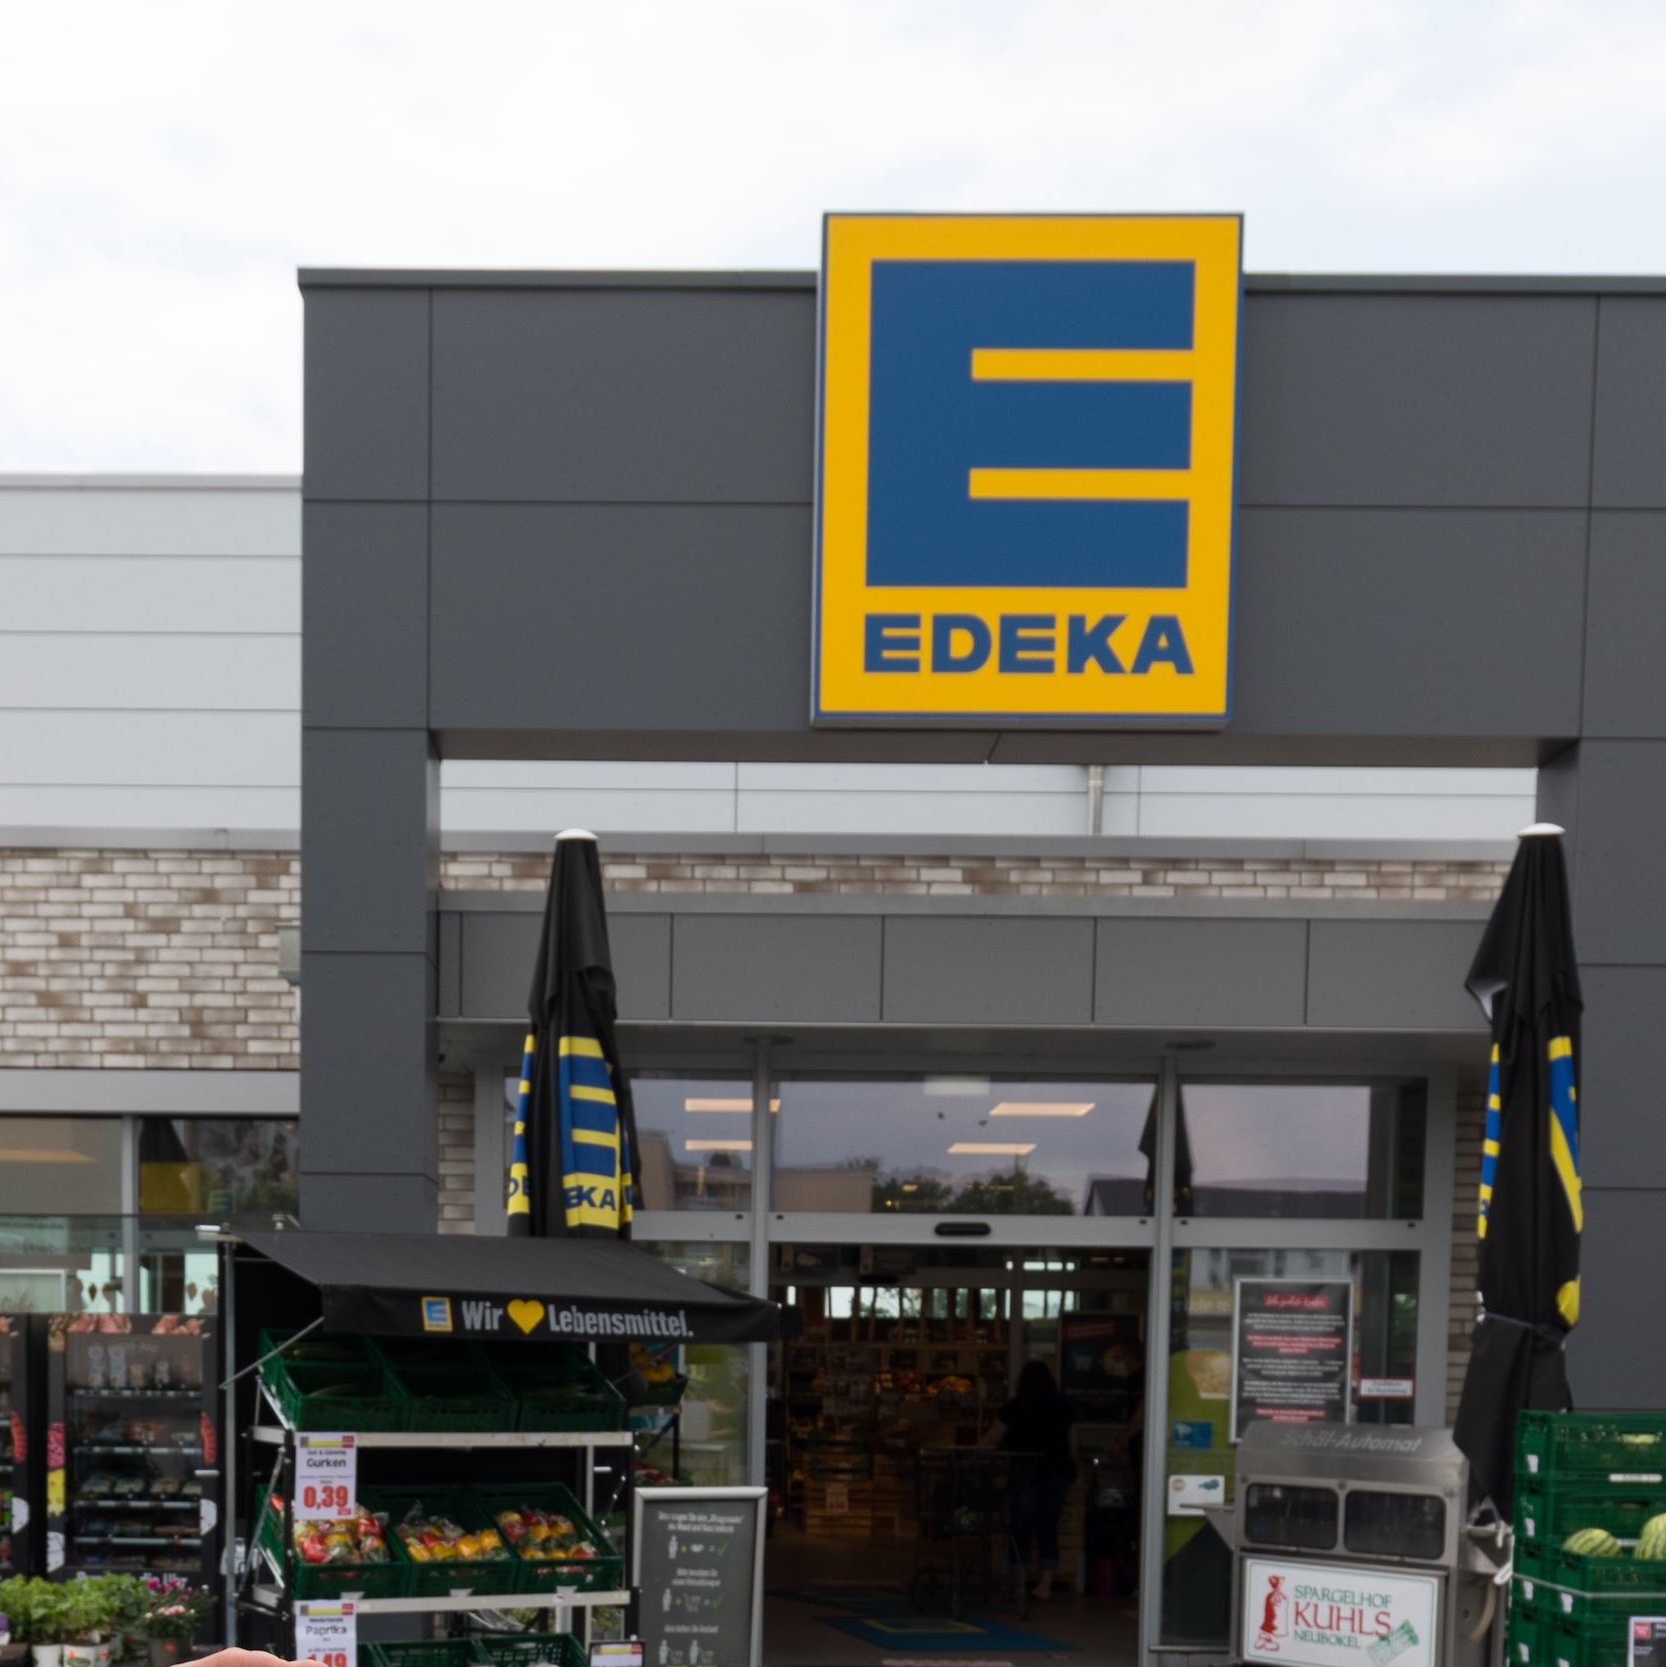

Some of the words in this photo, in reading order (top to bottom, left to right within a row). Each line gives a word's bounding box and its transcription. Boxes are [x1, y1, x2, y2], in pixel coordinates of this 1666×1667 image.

[864, 614, 1195, 674] EDEKA
[462, 1301, 503, 1330] Wir
[548, 1304, 694, 1337] Lebensmittel.
[1281, 1428, 1422, 1452] Schäl-Automat
[306, 1458, 347, 1468] Gurken
[303, 1485, 348, 1510] 0,39
[1294, 1585, 1392, 1608] SPARGELHOF
[306, 1625, 347, 1635] Paprika
[1294, 1601, 1391, 1637] KUHLS
[1293, 1629, 1361, 1649] NEUBOKEL
